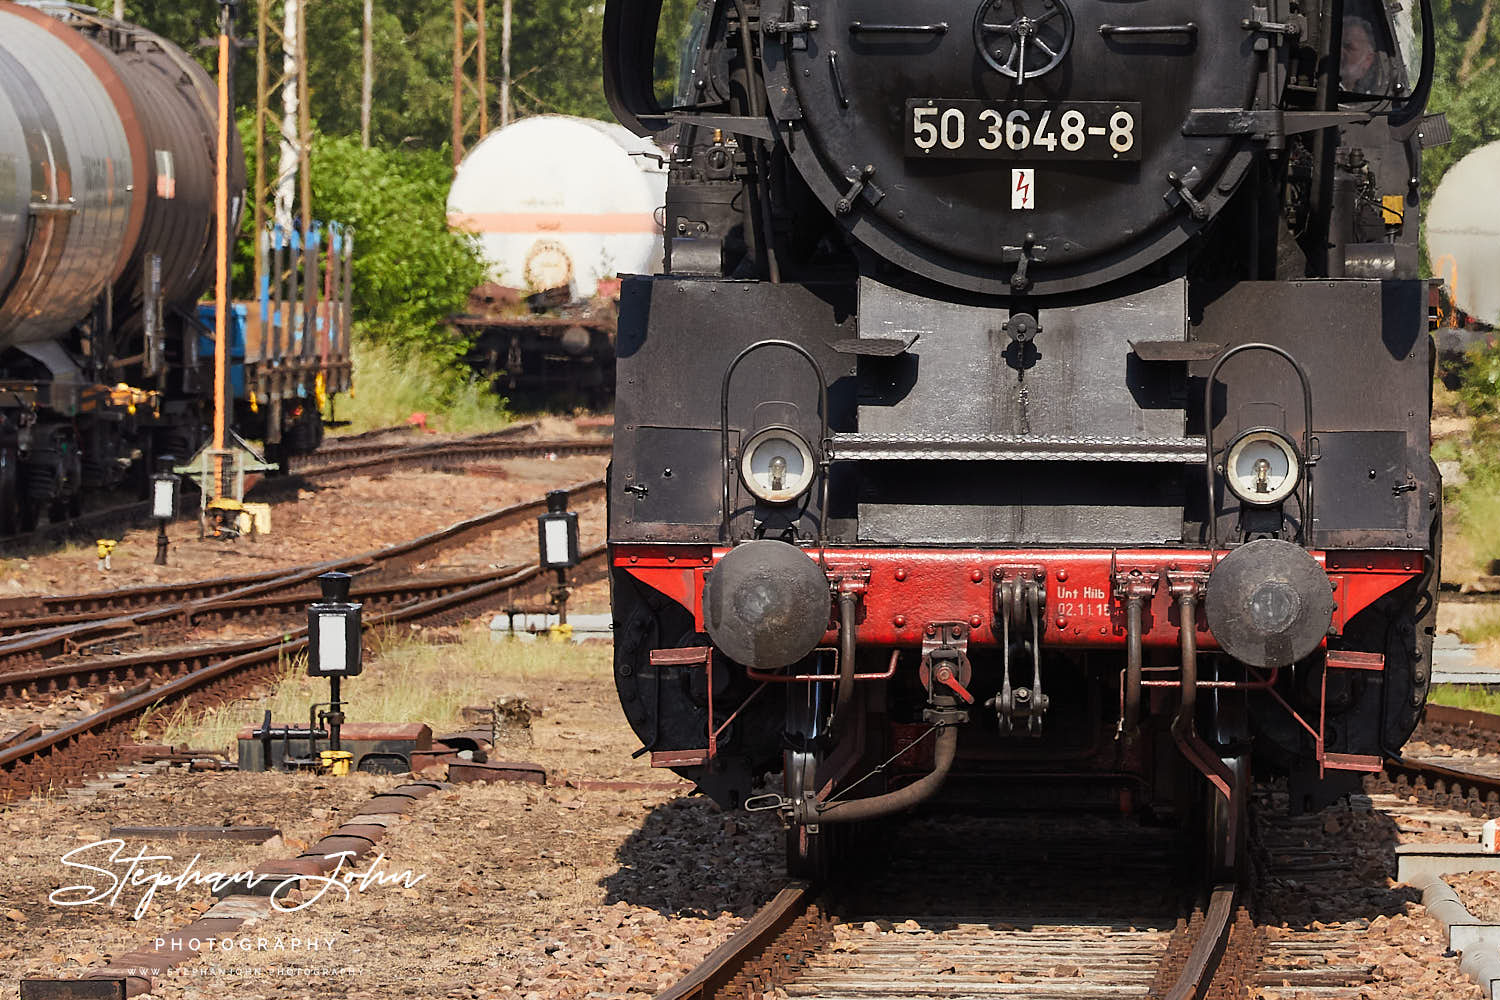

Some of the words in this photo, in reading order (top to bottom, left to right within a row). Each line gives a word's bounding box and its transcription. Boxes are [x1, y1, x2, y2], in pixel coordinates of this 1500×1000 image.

[913, 107, 965, 150] 50
[978, 109, 1134, 152] 3648-8
[1057, 586, 1079, 599] Unt
[1083, 586, 1105, 599] Hilb
